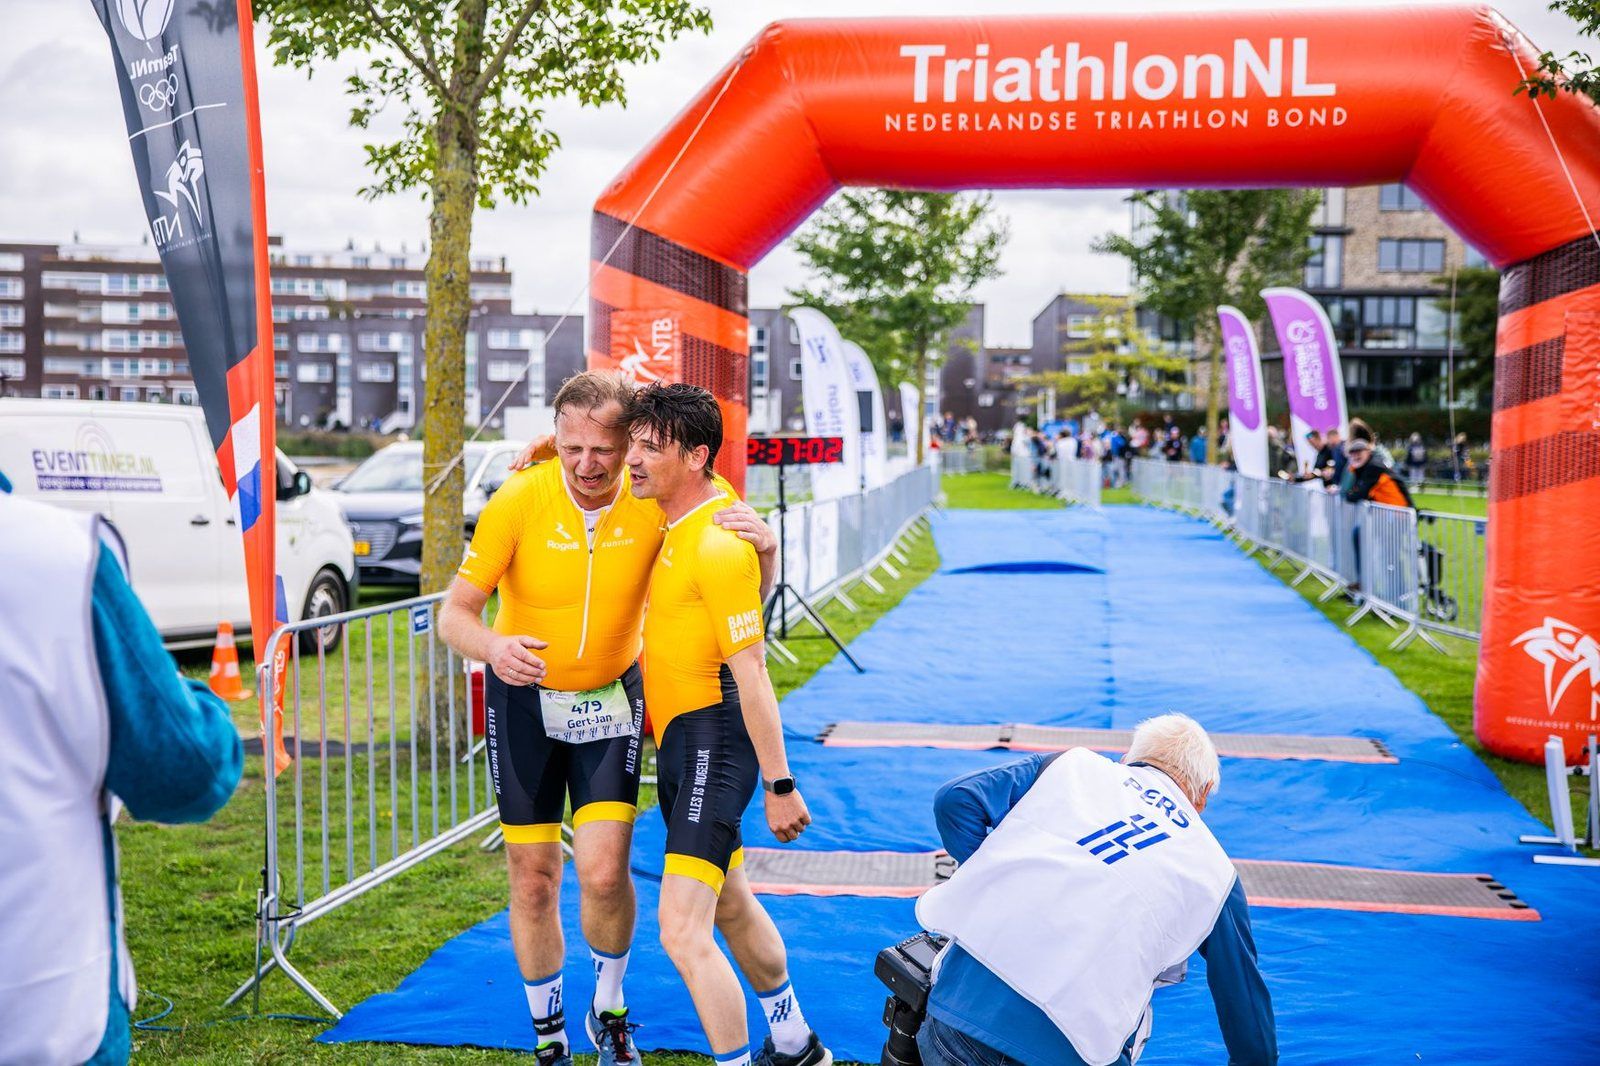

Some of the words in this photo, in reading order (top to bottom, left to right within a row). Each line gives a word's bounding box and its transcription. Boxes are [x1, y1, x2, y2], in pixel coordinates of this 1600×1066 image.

[900, 37, 1336, 103] TriathlonNL
[885, 111, 1077, 132] NEDERLANDSE
[1095, 108, 1248, 130] TRIATHLON
[1267, 106, 1348, 128] BOND
[652, 318, 673, 361] NTB
[727, 609, 759, 630] BANG
[730, 622, 761, 644] BANG
[571, 700, 602, 715] 479
[488, 706, 496, 736] ALLES
[567, 714, 612, 729] Gert-Jan
[489, 738, 498, 748] IS
[630, 739, 639, 749] IS
[491, 748, 501, 795] MOGELIJK
[625, 749, 637, 775] ALLES
[694, 749, 711, 786] MOGELIJK
[692, 786, 705, 796] IS
[1123, 777, 1191, 828] PERS
[688, 796, 703, 823] ALLES
